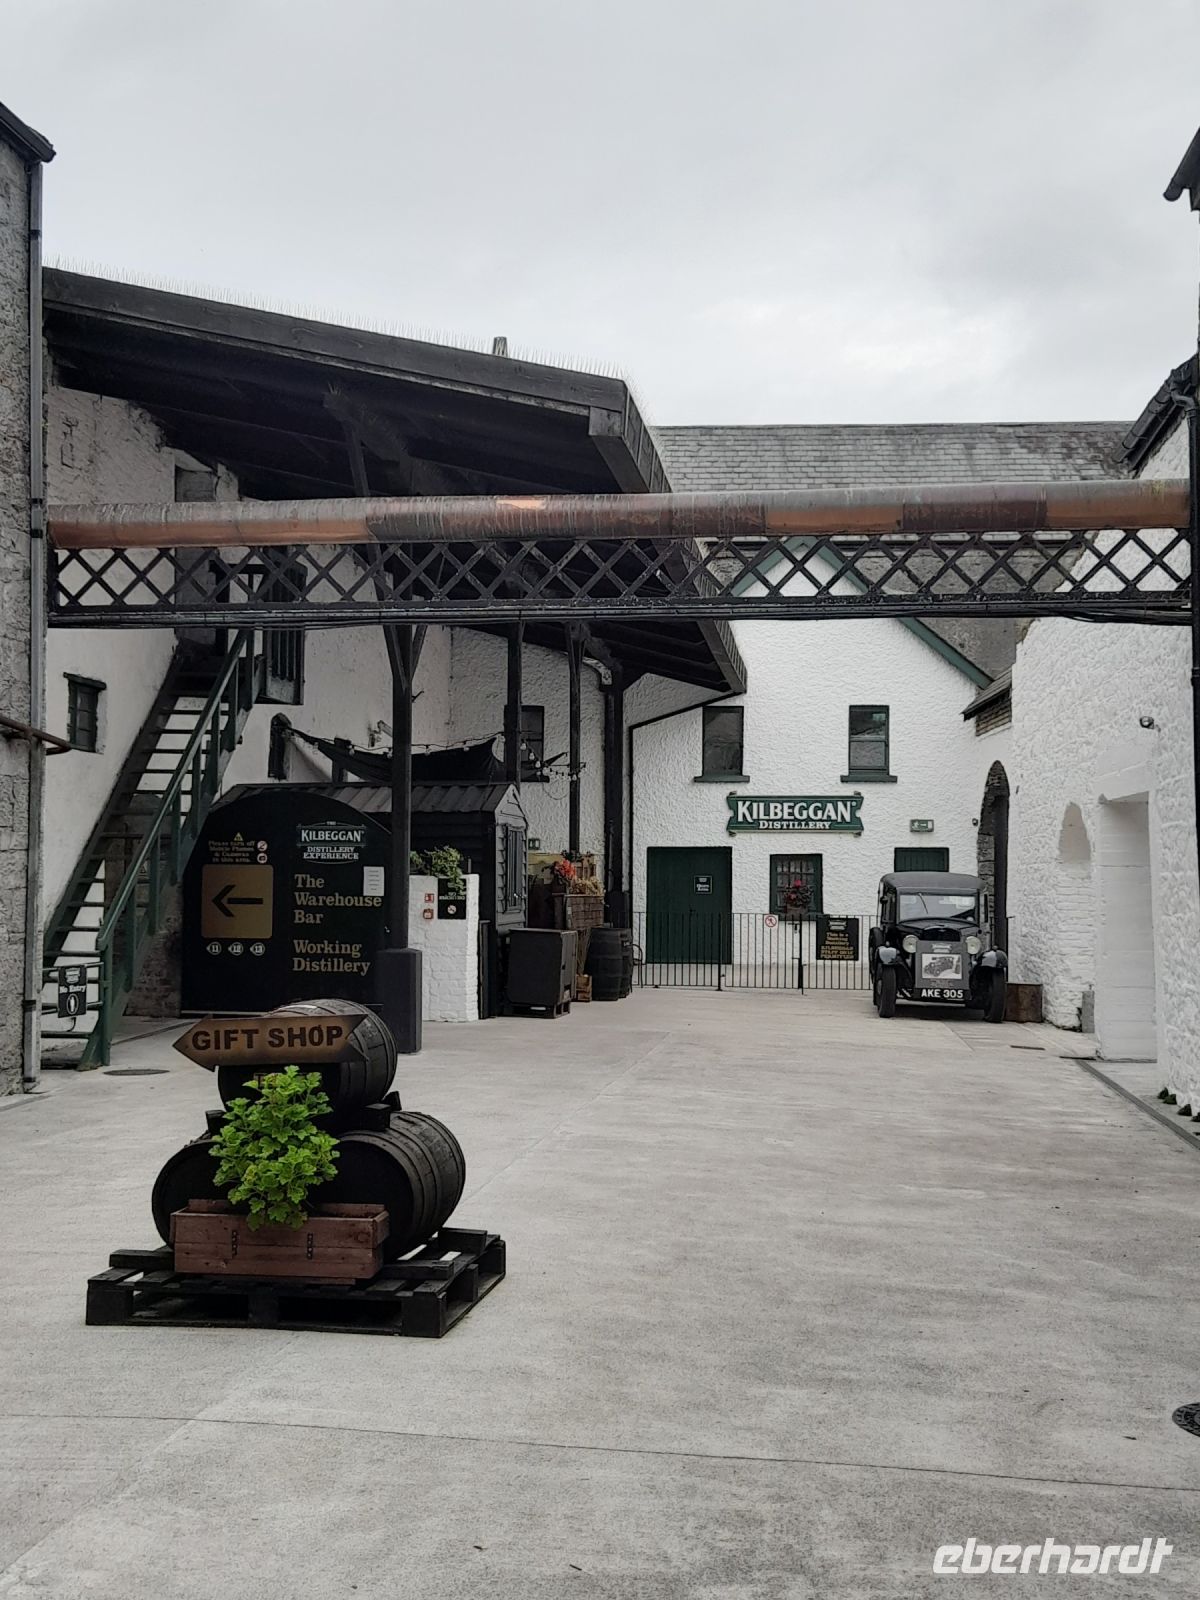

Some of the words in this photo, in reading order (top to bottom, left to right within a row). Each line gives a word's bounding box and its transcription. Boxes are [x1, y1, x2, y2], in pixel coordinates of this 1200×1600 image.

[737, 801, 851, 823] KILBEGGAN
[759, 820, 832, 830] DISTILLERY
[301, 829, 361, 842] KILBEGGAN
[294, 874, 325, 889] The
[294, 892, 382, 907] Warehouse
[293, 909, 324, 923] Bar
[293, 940, 362, 958] Working
[292, 957, 371, 976] Distillery
[59, 985, 68, 994] No
[69, 984, 87, 993] Entry
[921, 988, 941, 998] AKE
[943, 989, 964, 999] 305
[192, 1029, 259, 1050] GIFT
[268, 1025, 343, 1048] SHOP
